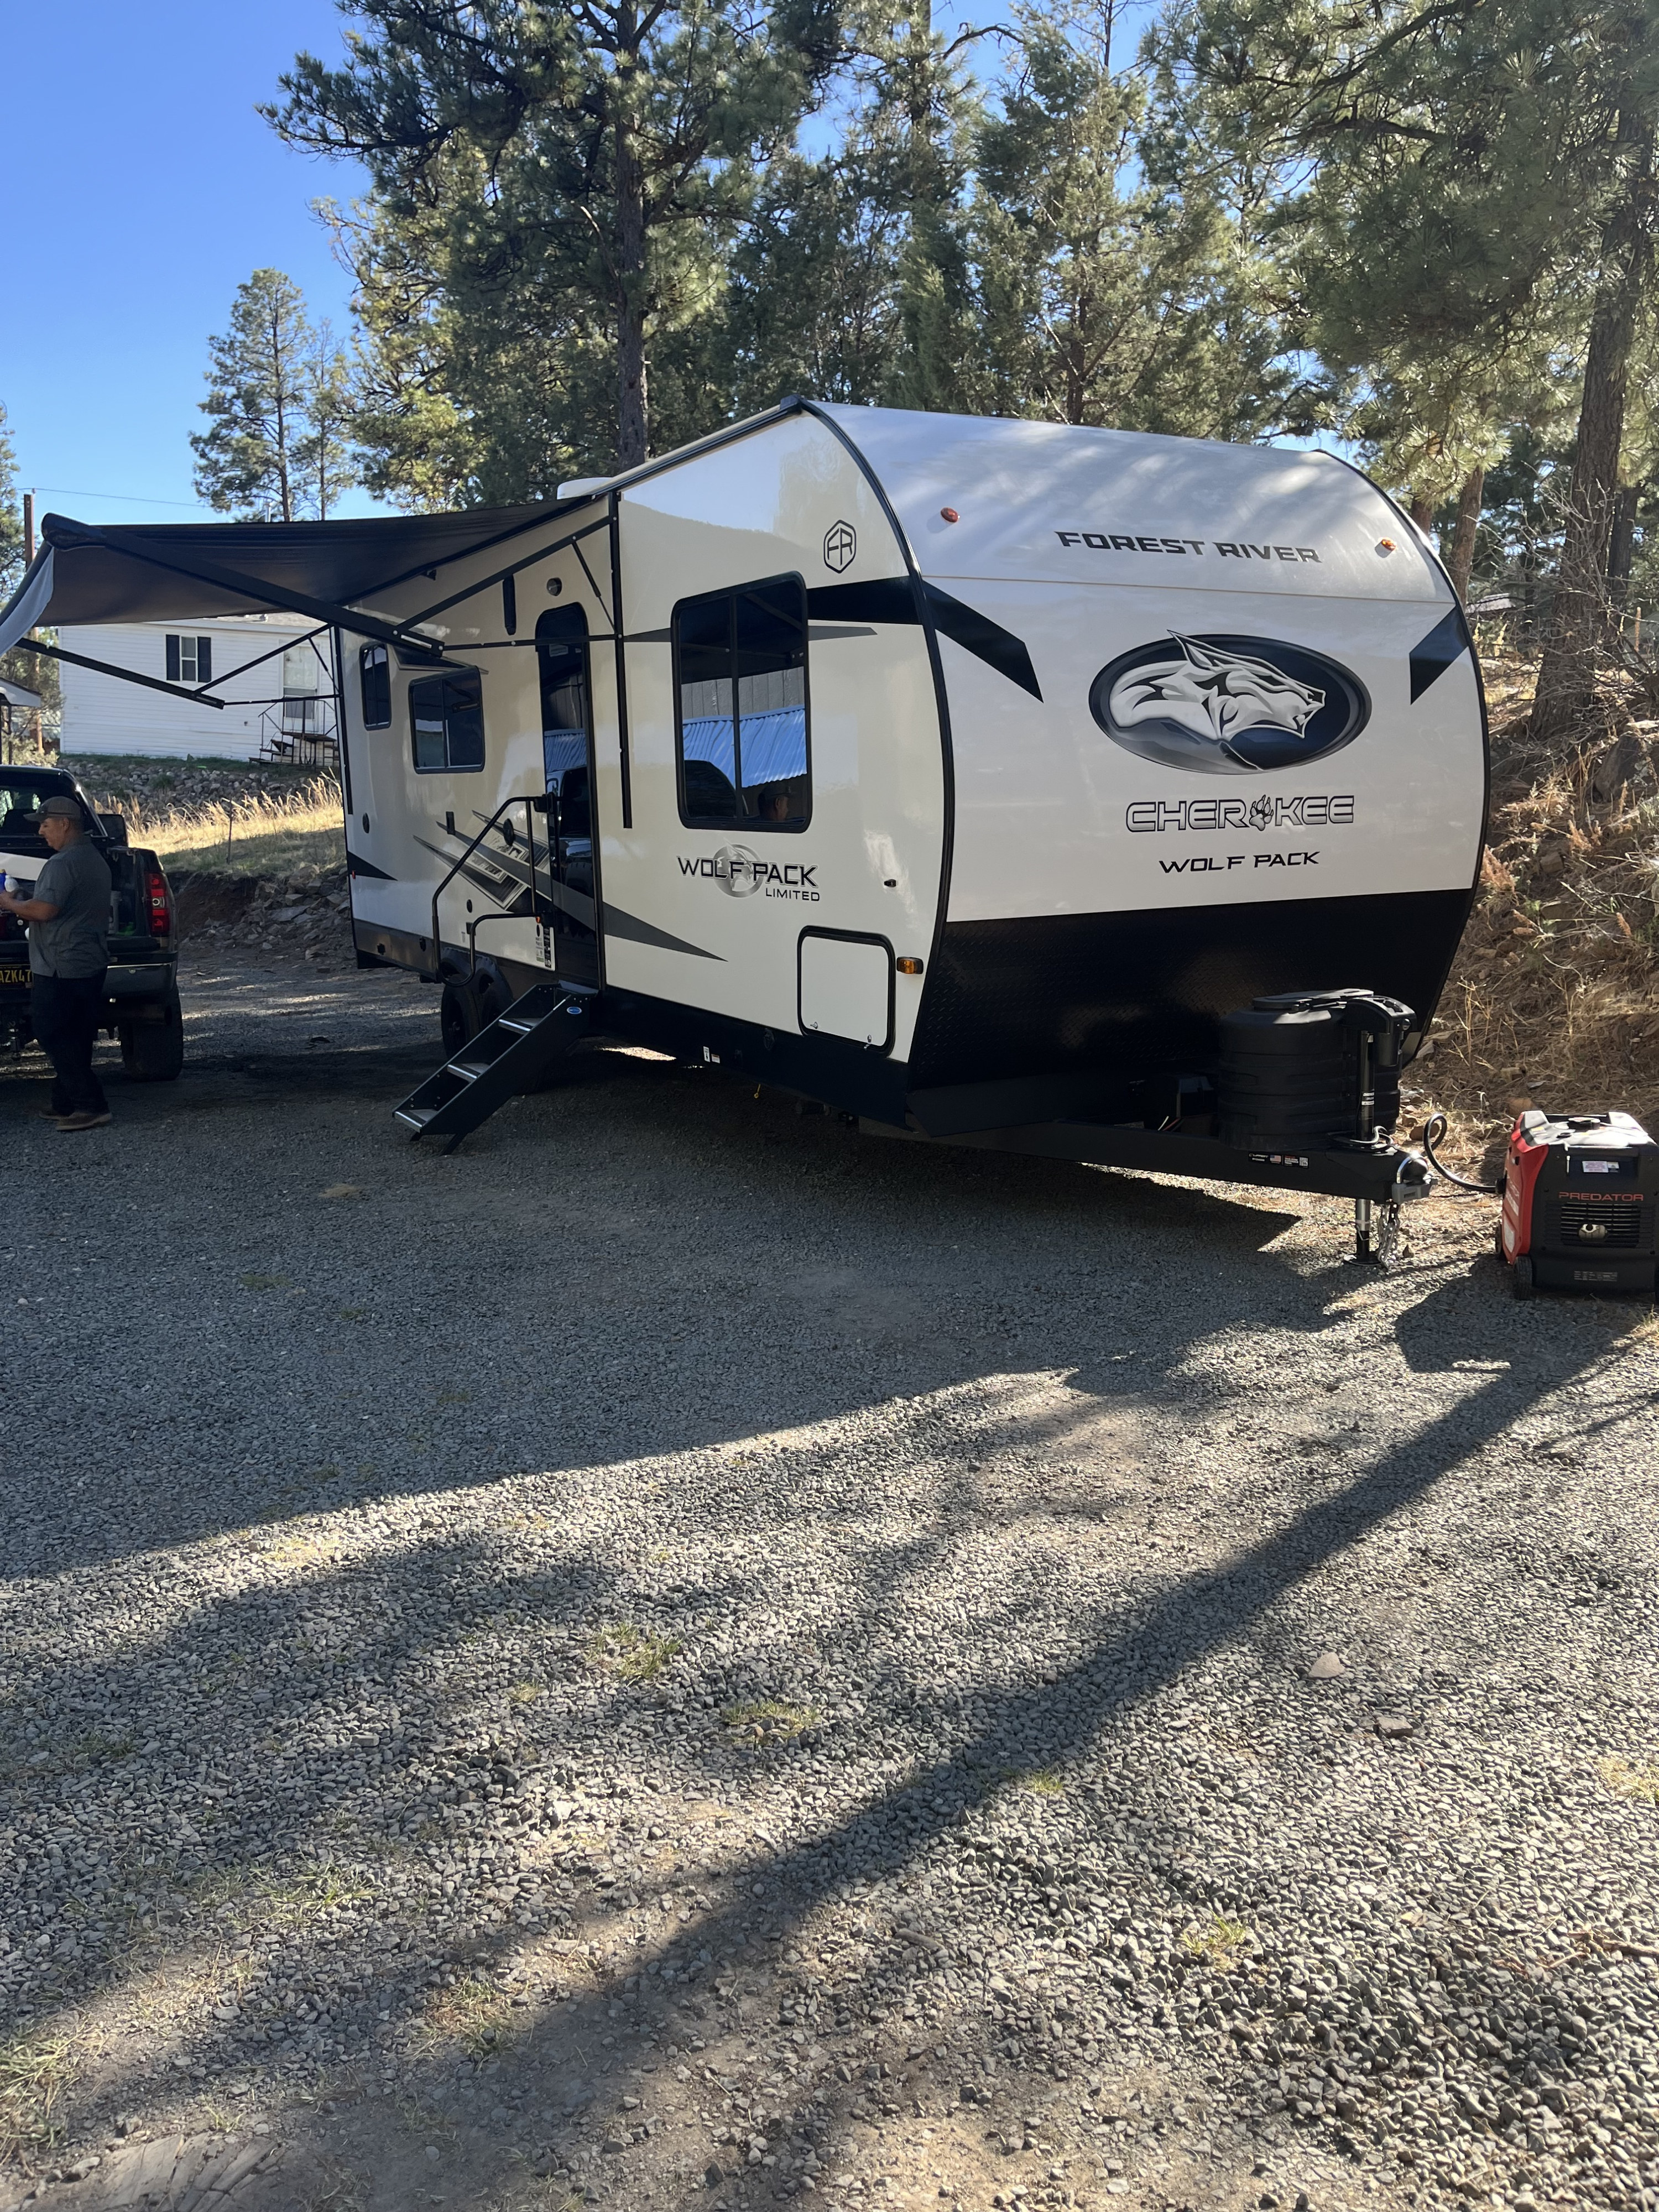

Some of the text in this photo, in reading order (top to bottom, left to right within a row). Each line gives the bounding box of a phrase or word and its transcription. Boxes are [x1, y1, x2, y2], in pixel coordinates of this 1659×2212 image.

[1054, 531, 1323, 564] FOREST RIVER
[676, 855, 819, 889] WOLF PACK
[1159, 851, 1321, 873] WOLF PACK
[766, 888, 820, 901] LIMITED
[1558, 1191, 1644, 1202] PREDATOR
